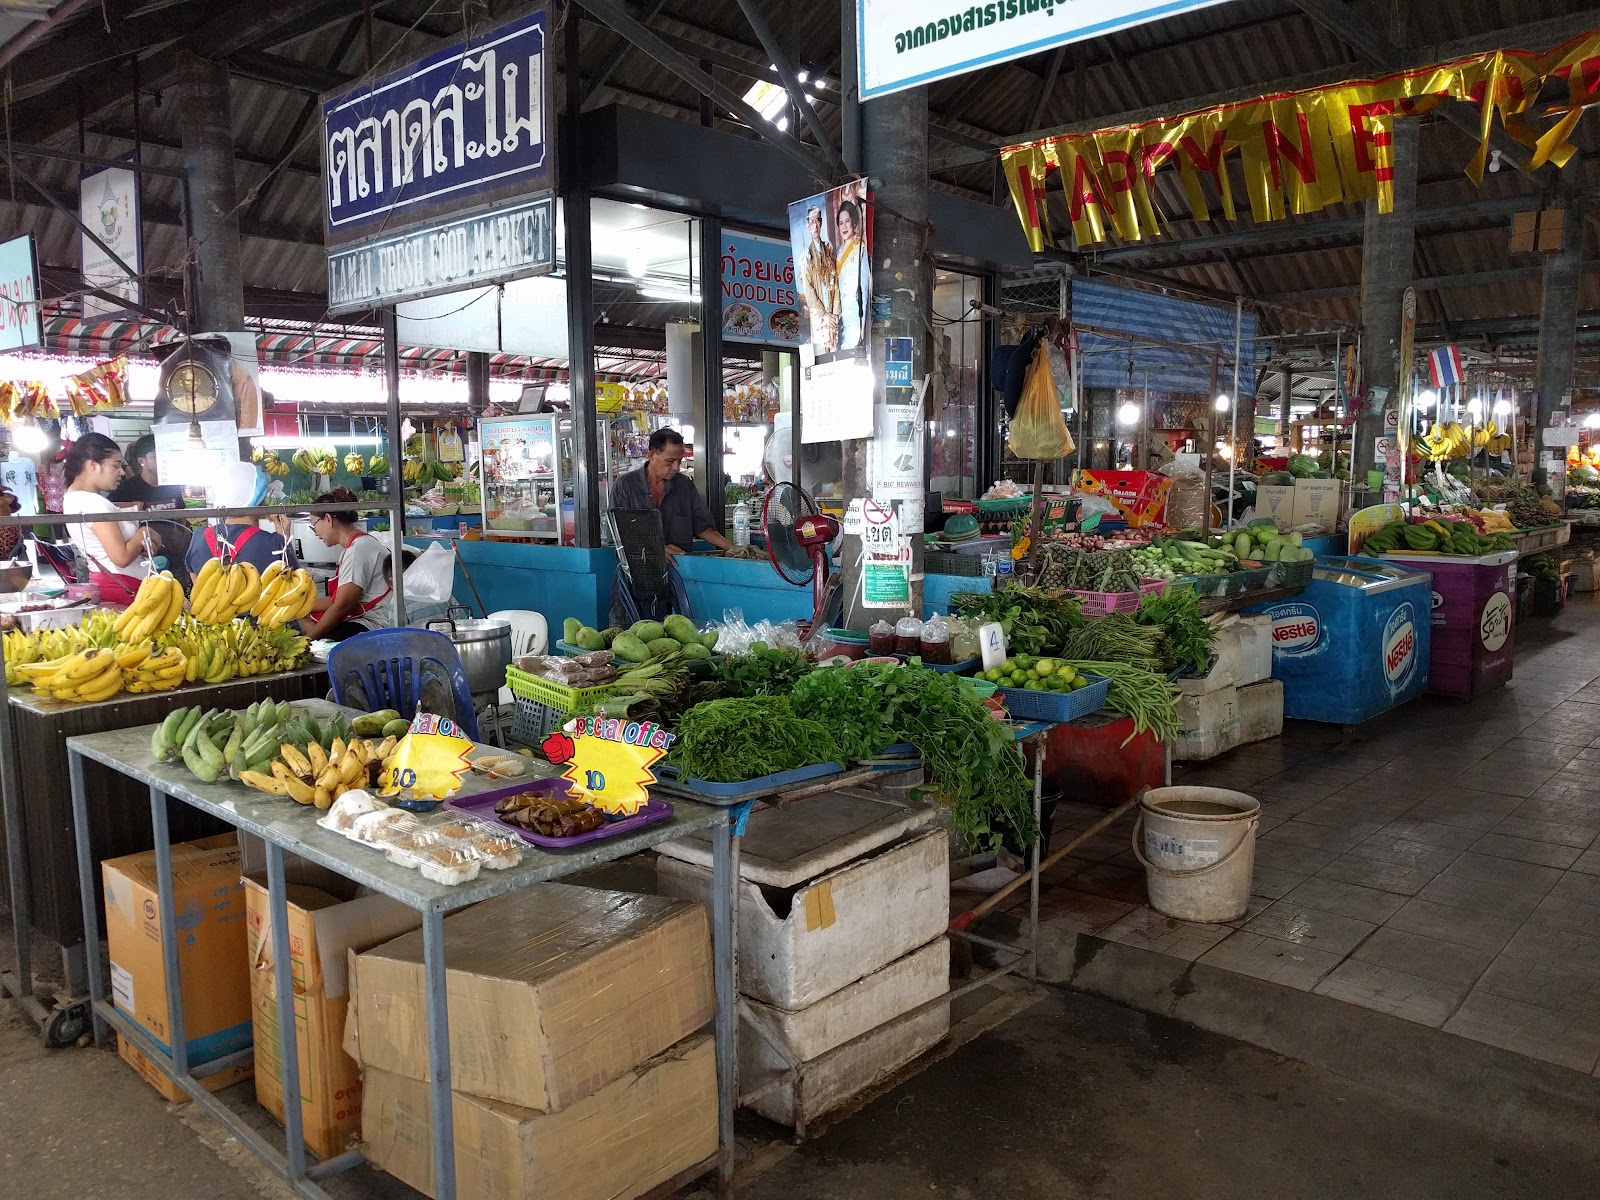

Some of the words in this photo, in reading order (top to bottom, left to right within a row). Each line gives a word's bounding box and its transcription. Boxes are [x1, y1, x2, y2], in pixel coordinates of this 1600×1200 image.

[329, 50, 541, 207] ตลาดละไม
[331, 251, 373, 303] LAMAI
[378, 237, 425, 293] FRESH
[428, 227, 467, 282] FOOD
[474, 206, 549, 274] MARKET
[721, 280, 795, 306] NOODLES
[1113, 489, 1137, 497] DRAGON
[1119, 497, 1136, 505] FRUIT
[865, 526, 892, 542] เขต
[573, 716, 627, 744] pecial
[391, 767, 416, 788] 20
[585, 770, 606, 791] 10
